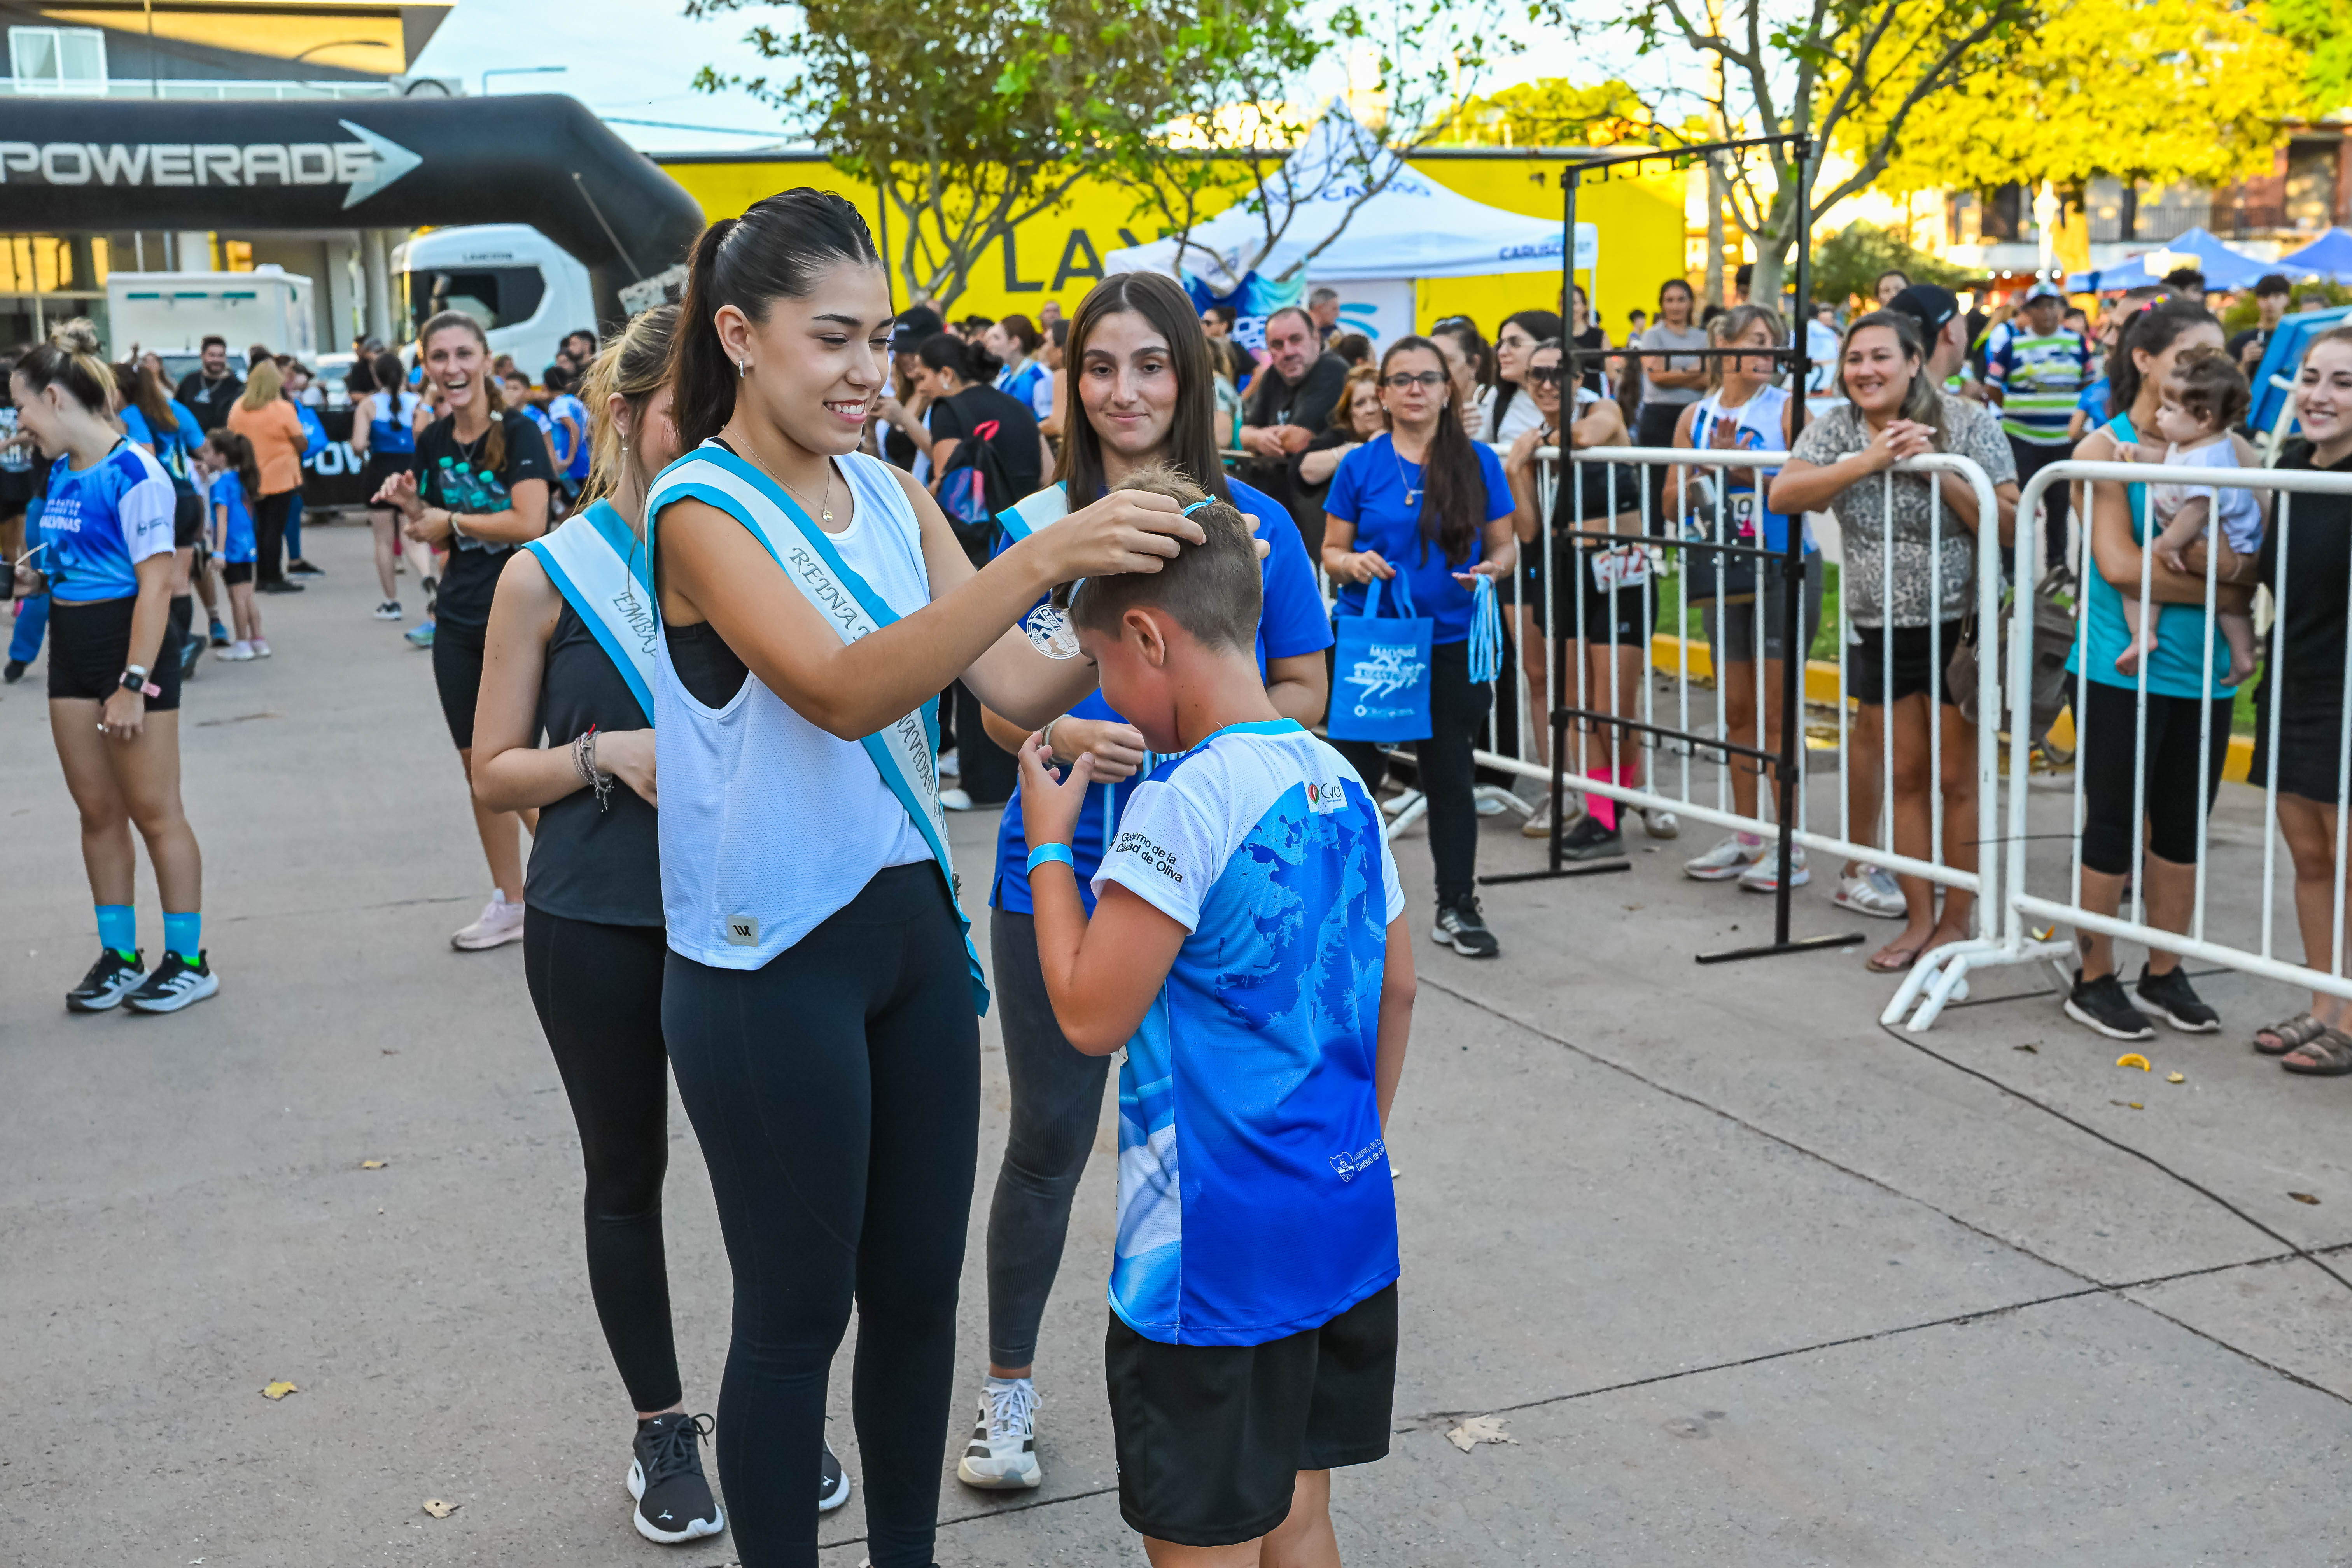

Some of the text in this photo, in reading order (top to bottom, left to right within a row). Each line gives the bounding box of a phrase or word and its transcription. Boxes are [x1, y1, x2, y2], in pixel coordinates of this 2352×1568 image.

[0, 142, 375, 185] POWERADE
[789, 547, 858, 630] REINA
[1141, 852, 1153, 864] de
[1156, 861, 1183, 883] Oliva
[1152, 846, 1165, 858] de
[1167, 852, 1176, 864] la
[1355, 1155, 1373, 1171] Ciudad
